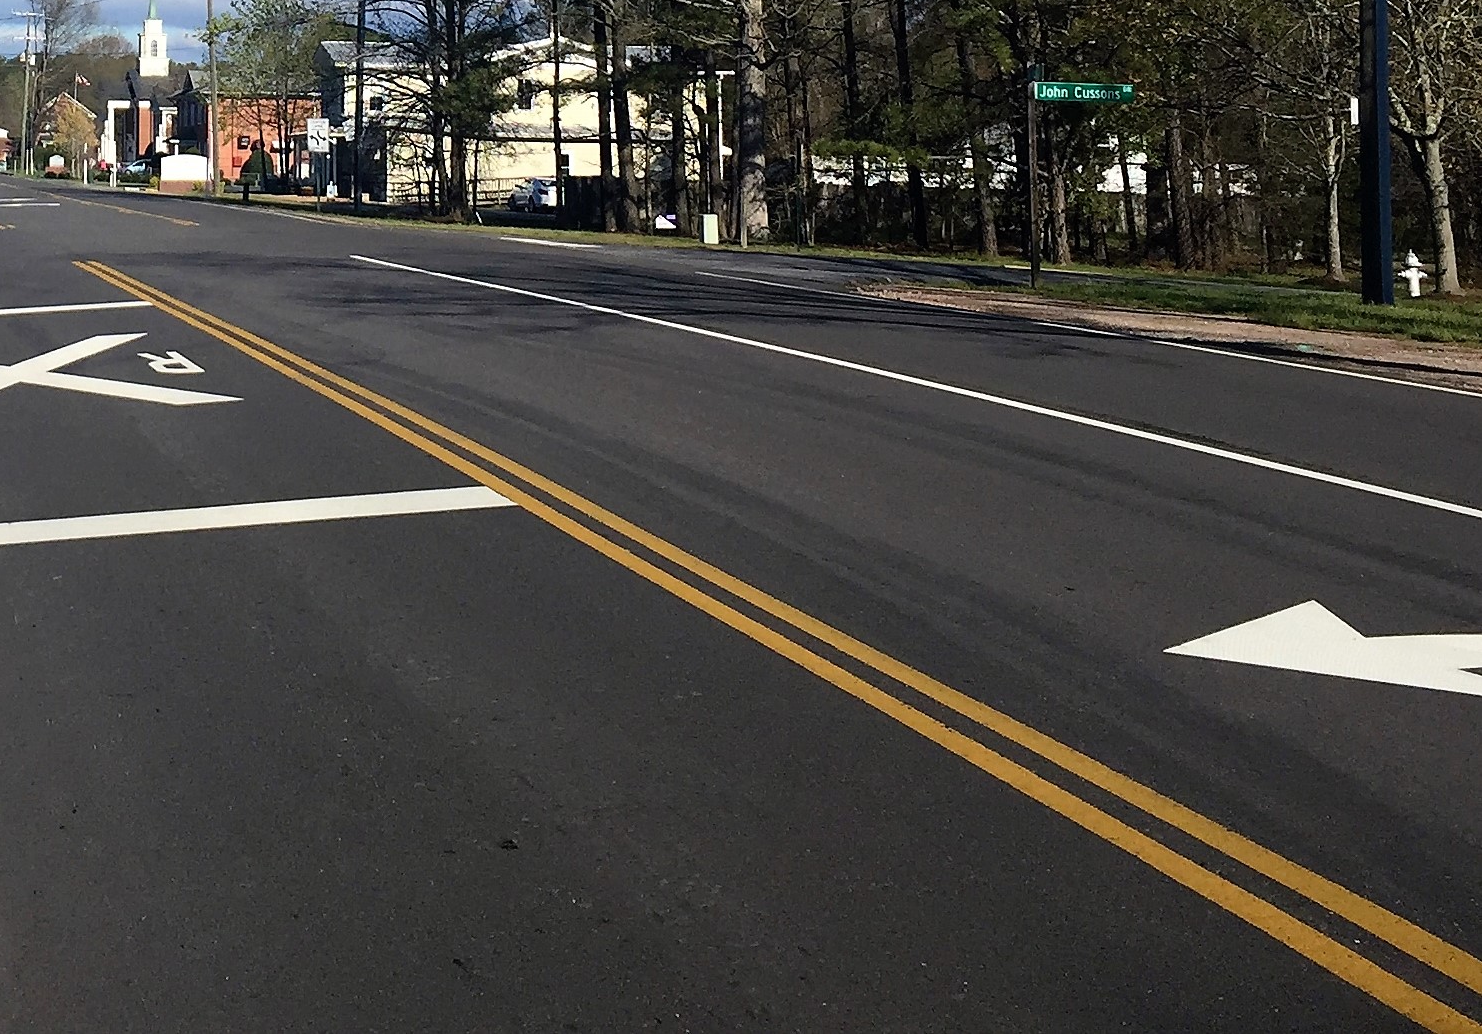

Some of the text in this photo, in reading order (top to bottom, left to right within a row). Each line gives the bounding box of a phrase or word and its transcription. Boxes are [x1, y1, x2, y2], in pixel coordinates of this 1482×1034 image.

[1039, 85, 1069, 99] John
[1074, 86, 1121, 100] Cussons
[137, 350, 206, 374] R
